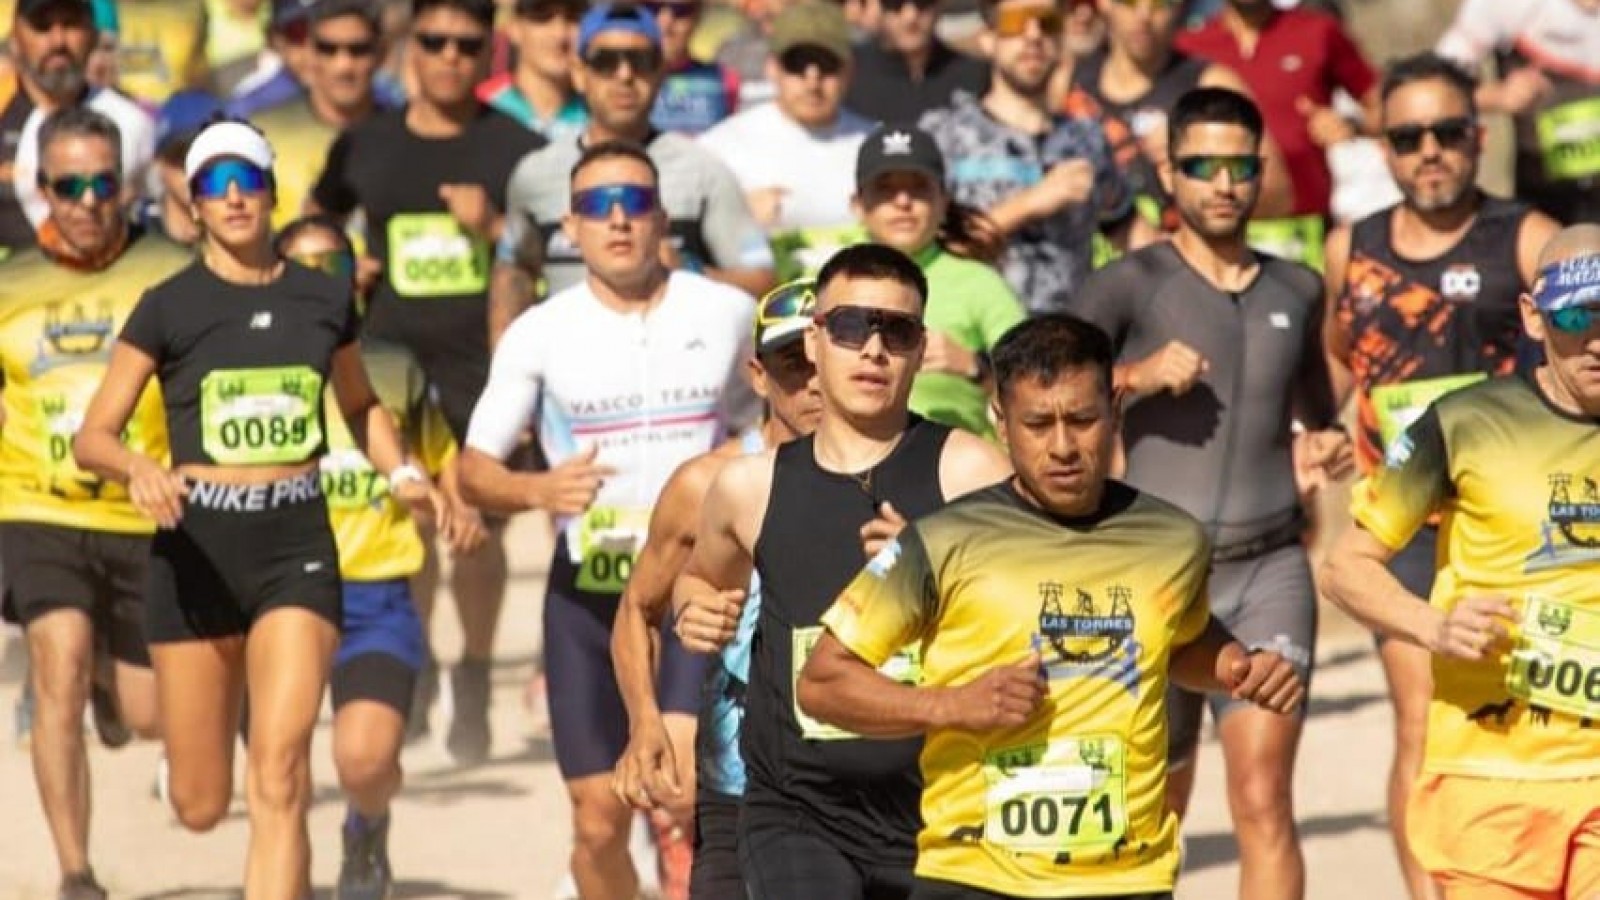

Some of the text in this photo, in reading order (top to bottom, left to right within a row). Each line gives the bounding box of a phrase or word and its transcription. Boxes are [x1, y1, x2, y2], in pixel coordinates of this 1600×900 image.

[571, 384, 720, 414] VASCO TEAM
[220, 414, 308, 450] 0089
[189, 478, 267, 511] NIKE
[1041, 616, 1132, 632] LAS TORRES
[1001, 793, 1113, 836] 0071
